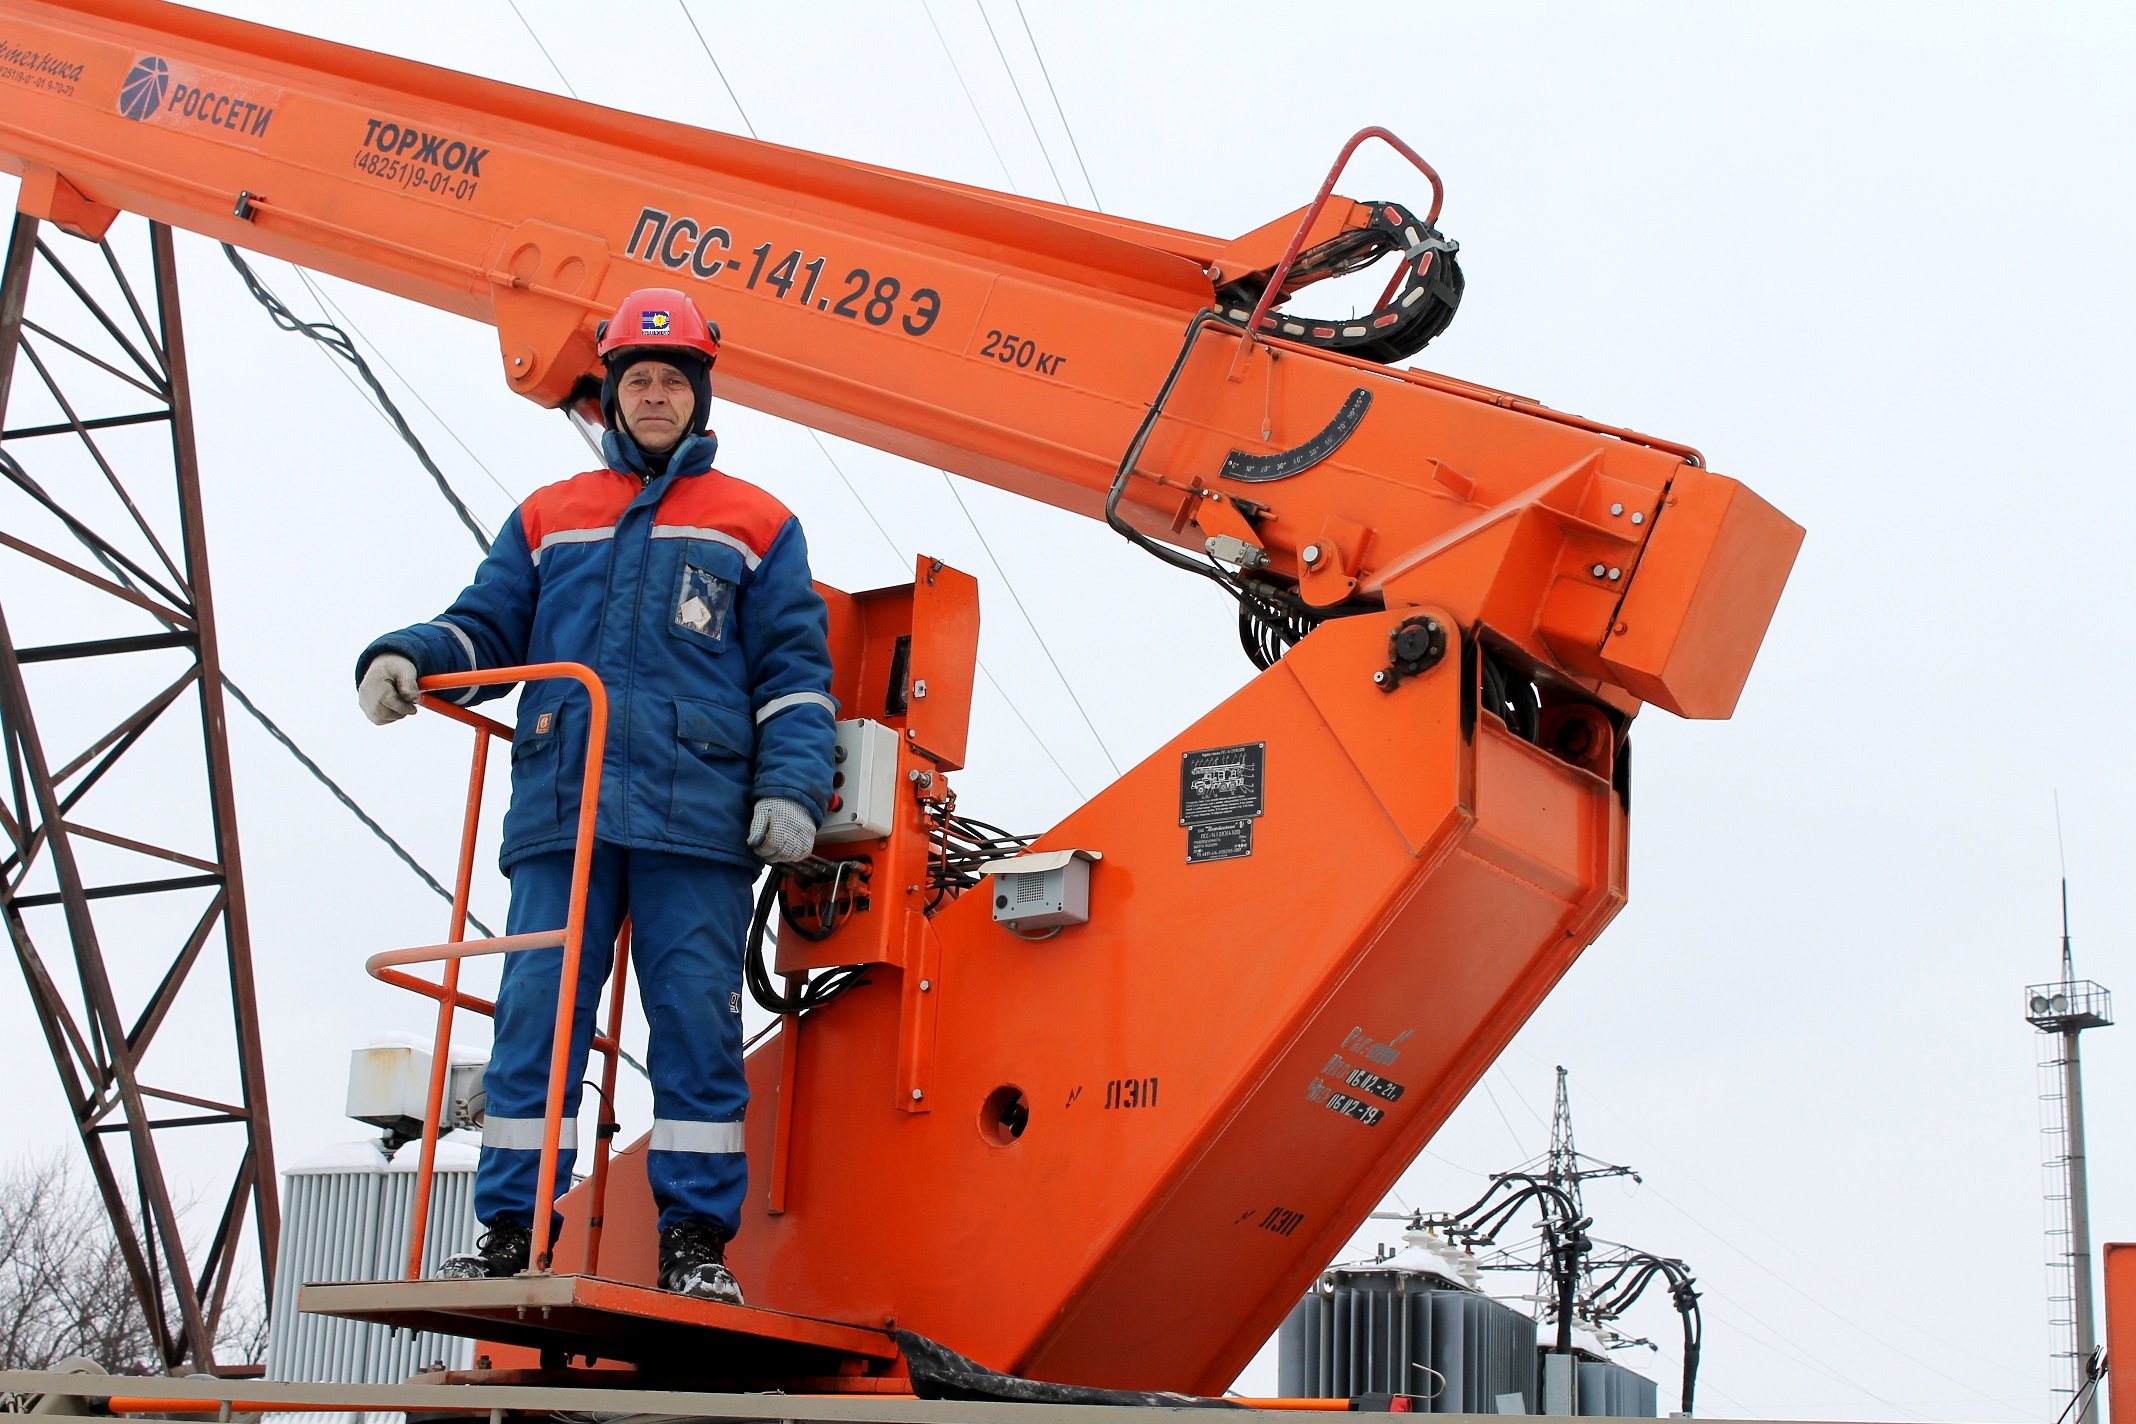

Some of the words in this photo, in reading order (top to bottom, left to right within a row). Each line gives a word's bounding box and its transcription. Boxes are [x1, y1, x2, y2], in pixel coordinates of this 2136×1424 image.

[168, 83, 273, 138] РОССЕТИ
[363, 118, 489, 179] ТОРЖОК
[353, 149, 478, 202] (48251)9-01-01
[980, 330, 1036, 369] 250
[1035, 352, 1067, 376] кг
[1104, 1077, 1159, 1110] ЛЭП
[1258, 1206, 1305, 1237] ЛЭП
